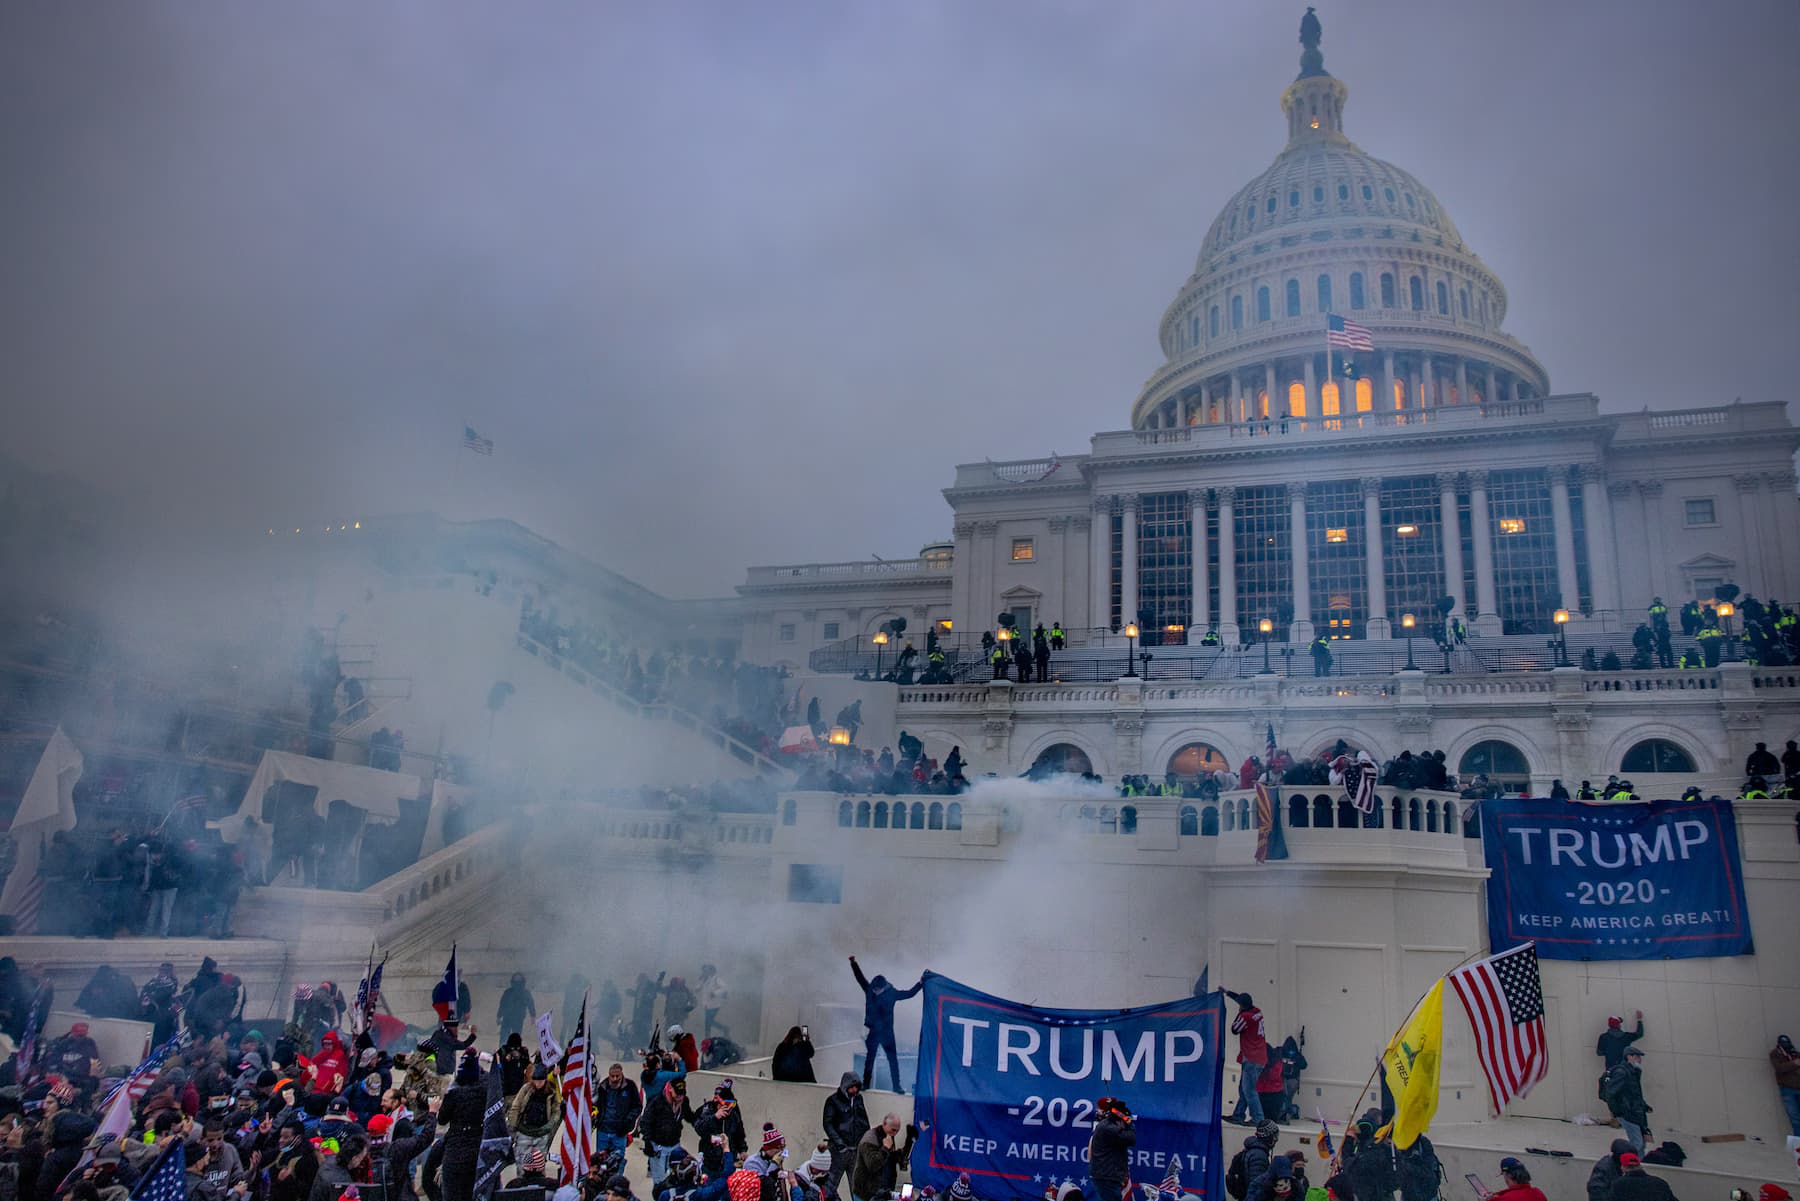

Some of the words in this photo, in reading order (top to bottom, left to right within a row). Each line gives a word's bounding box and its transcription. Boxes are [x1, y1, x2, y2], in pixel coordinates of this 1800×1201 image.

[1508, 820, 1709, 869] TRUMP
[1566, 879, 1670, 905] -2020-
[1519, 913, 1563, 928] KEEP
[1570, 915, 1655, 929] AMERICA
[1661, 909, 1731, 926] GREAT!
[949, 1015, 1204, 1083] TRUMP
[1007, 1095, 1095, 1129] -202
[943, 1133, 998, 1155] KEEP
[1006, 1142, 1090, 1164] AMERIC
